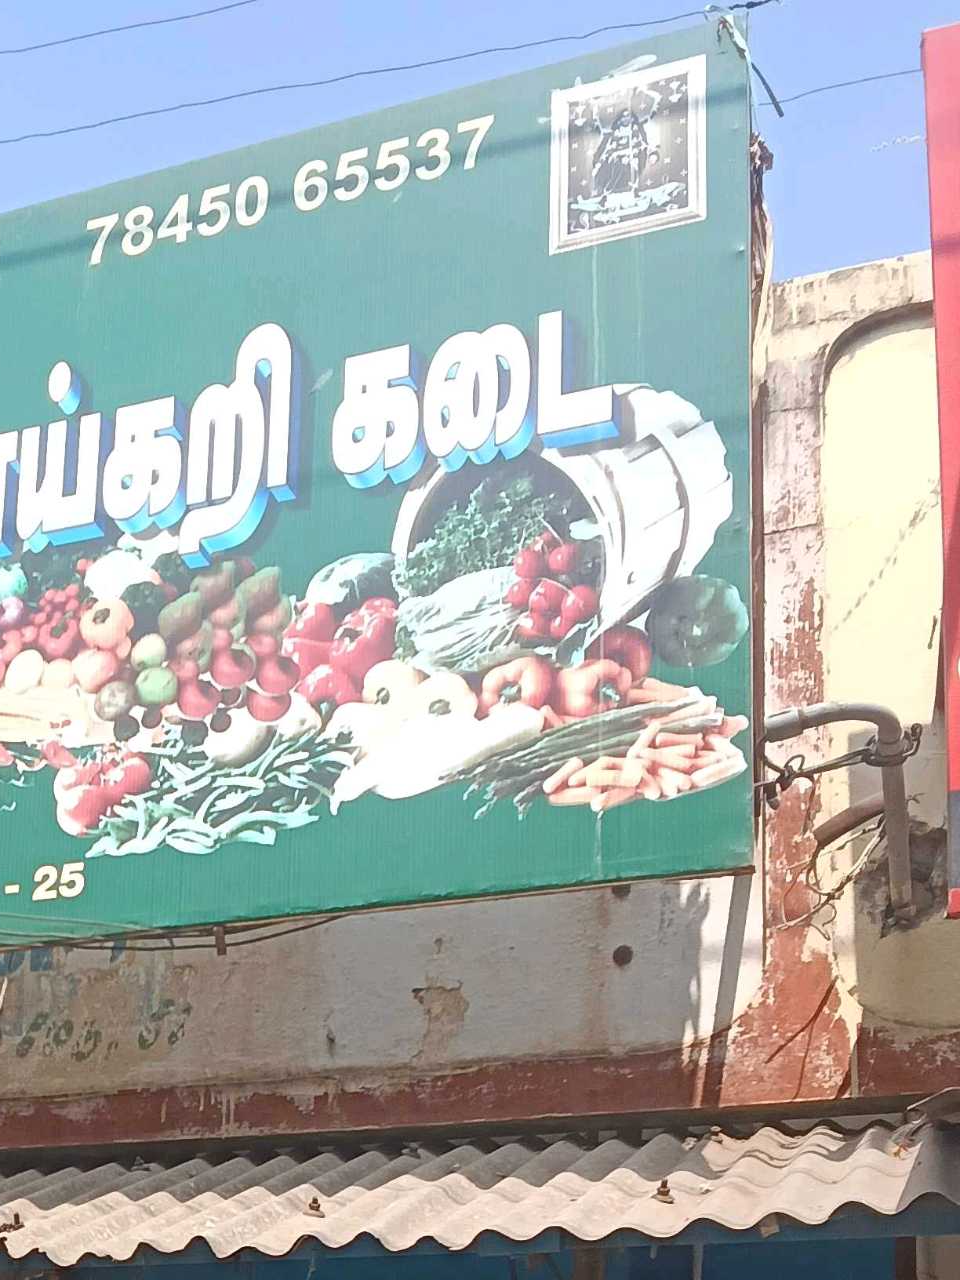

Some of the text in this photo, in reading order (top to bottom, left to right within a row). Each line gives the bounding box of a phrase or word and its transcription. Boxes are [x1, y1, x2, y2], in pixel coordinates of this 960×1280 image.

[85, 114, 496, 267] 78450 65537
[332, 310, 620, 488] கடை
[32, 861, 87, 901] 25
